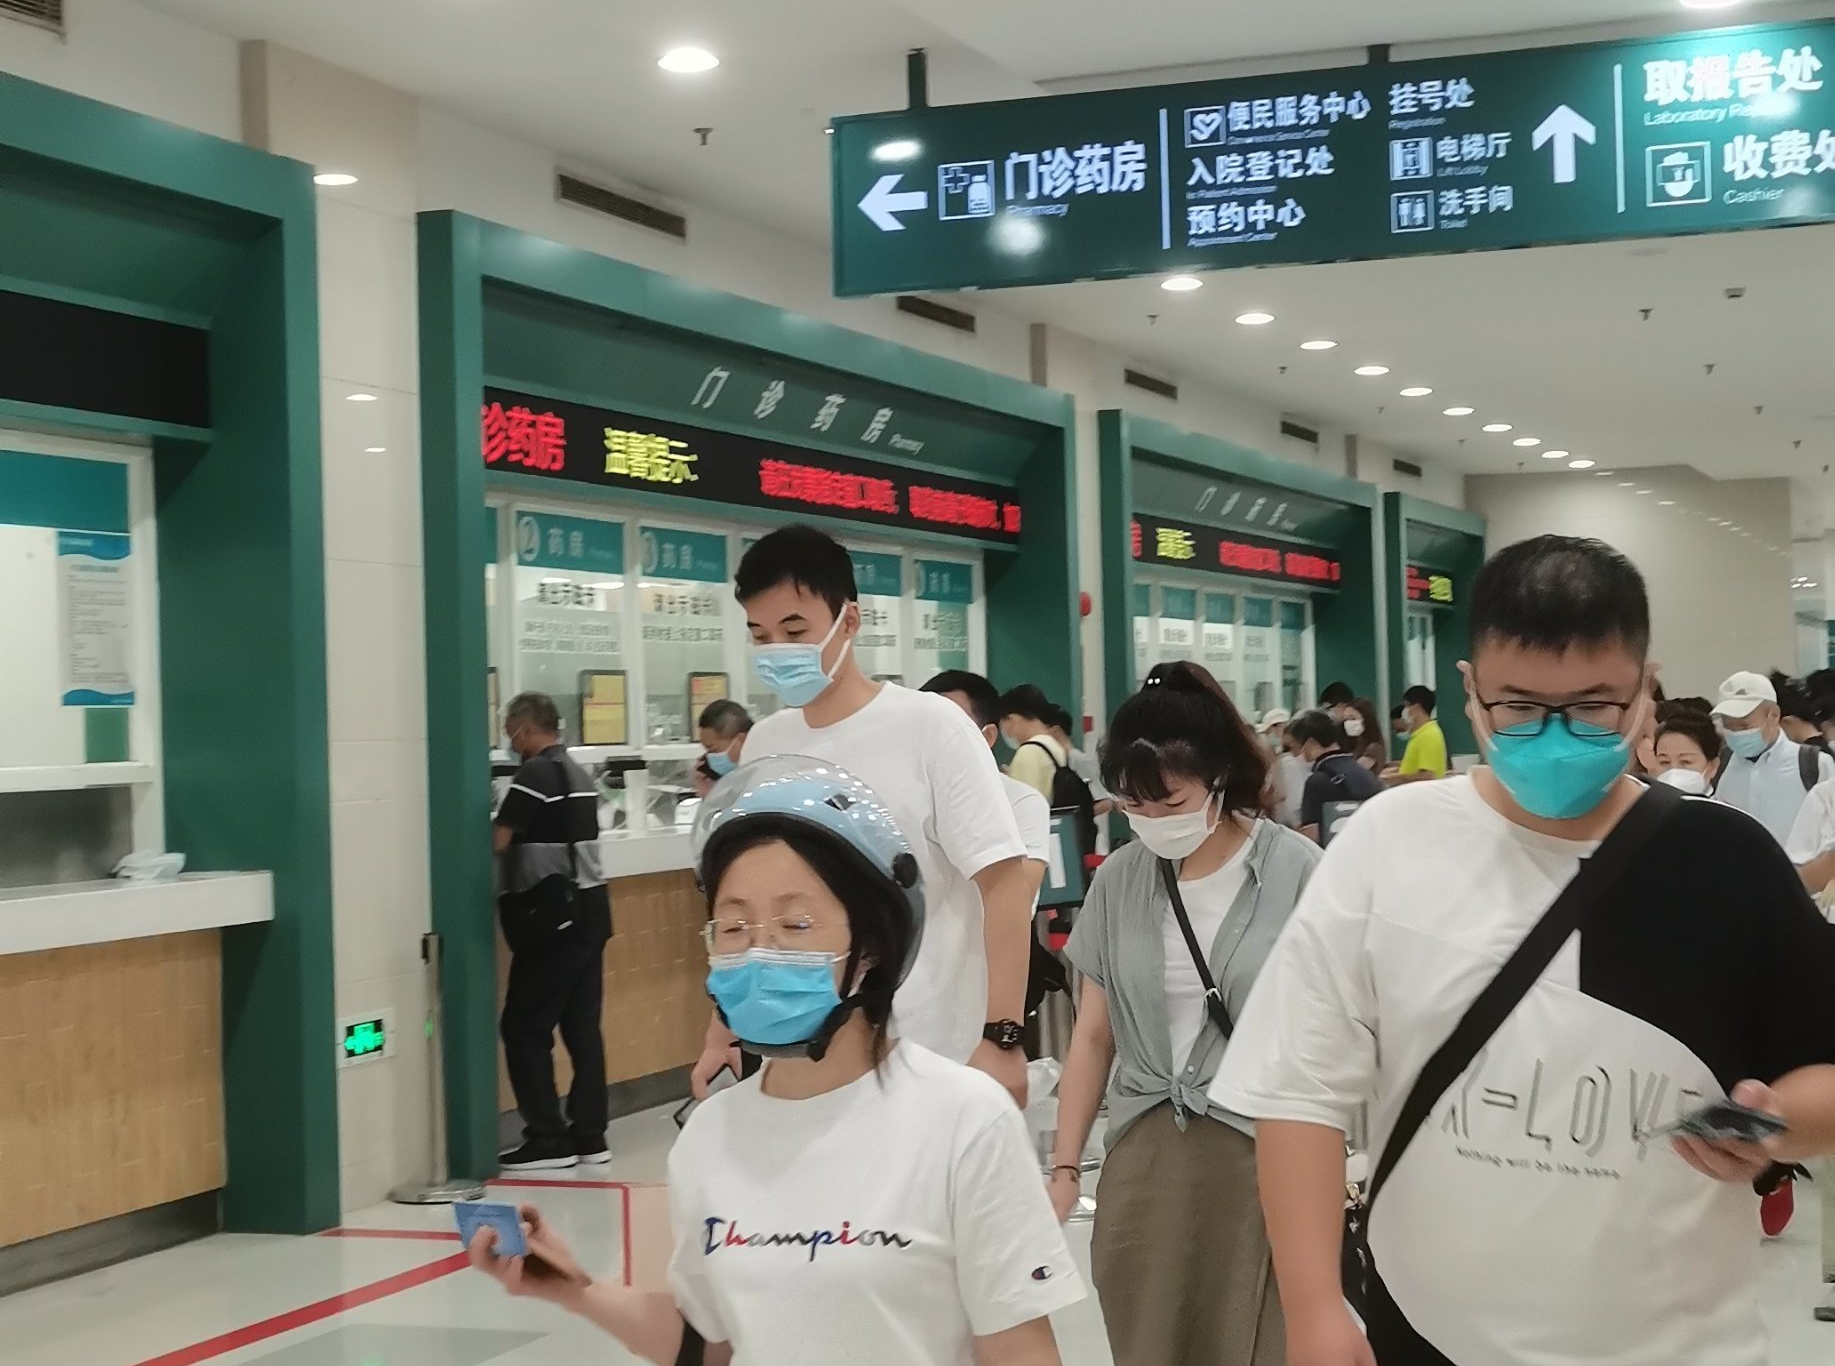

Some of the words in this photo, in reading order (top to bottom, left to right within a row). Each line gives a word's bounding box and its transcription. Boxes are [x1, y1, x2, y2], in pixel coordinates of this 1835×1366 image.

[1388, 77, 1475, 115] 挂号处
[1643, 45, 1824, 106] 取报告处
[1227, 89, 1372, 132] 便民服务中心
[1186, 145, 1336, 186] 入院登记处
[1436, 132, 1512, 162] 电梯厅
[1004, 140, 1148, 200] 门诊药房
[1186, 197, 1307, 236] 预约中心
[1438, 185, 1514, 216] 洗手间
[1723, 188, 1784, 205] Cashier
[691, 366, 893, 444] 门诊药房
[703, 1216, 913, 1262] Champion
